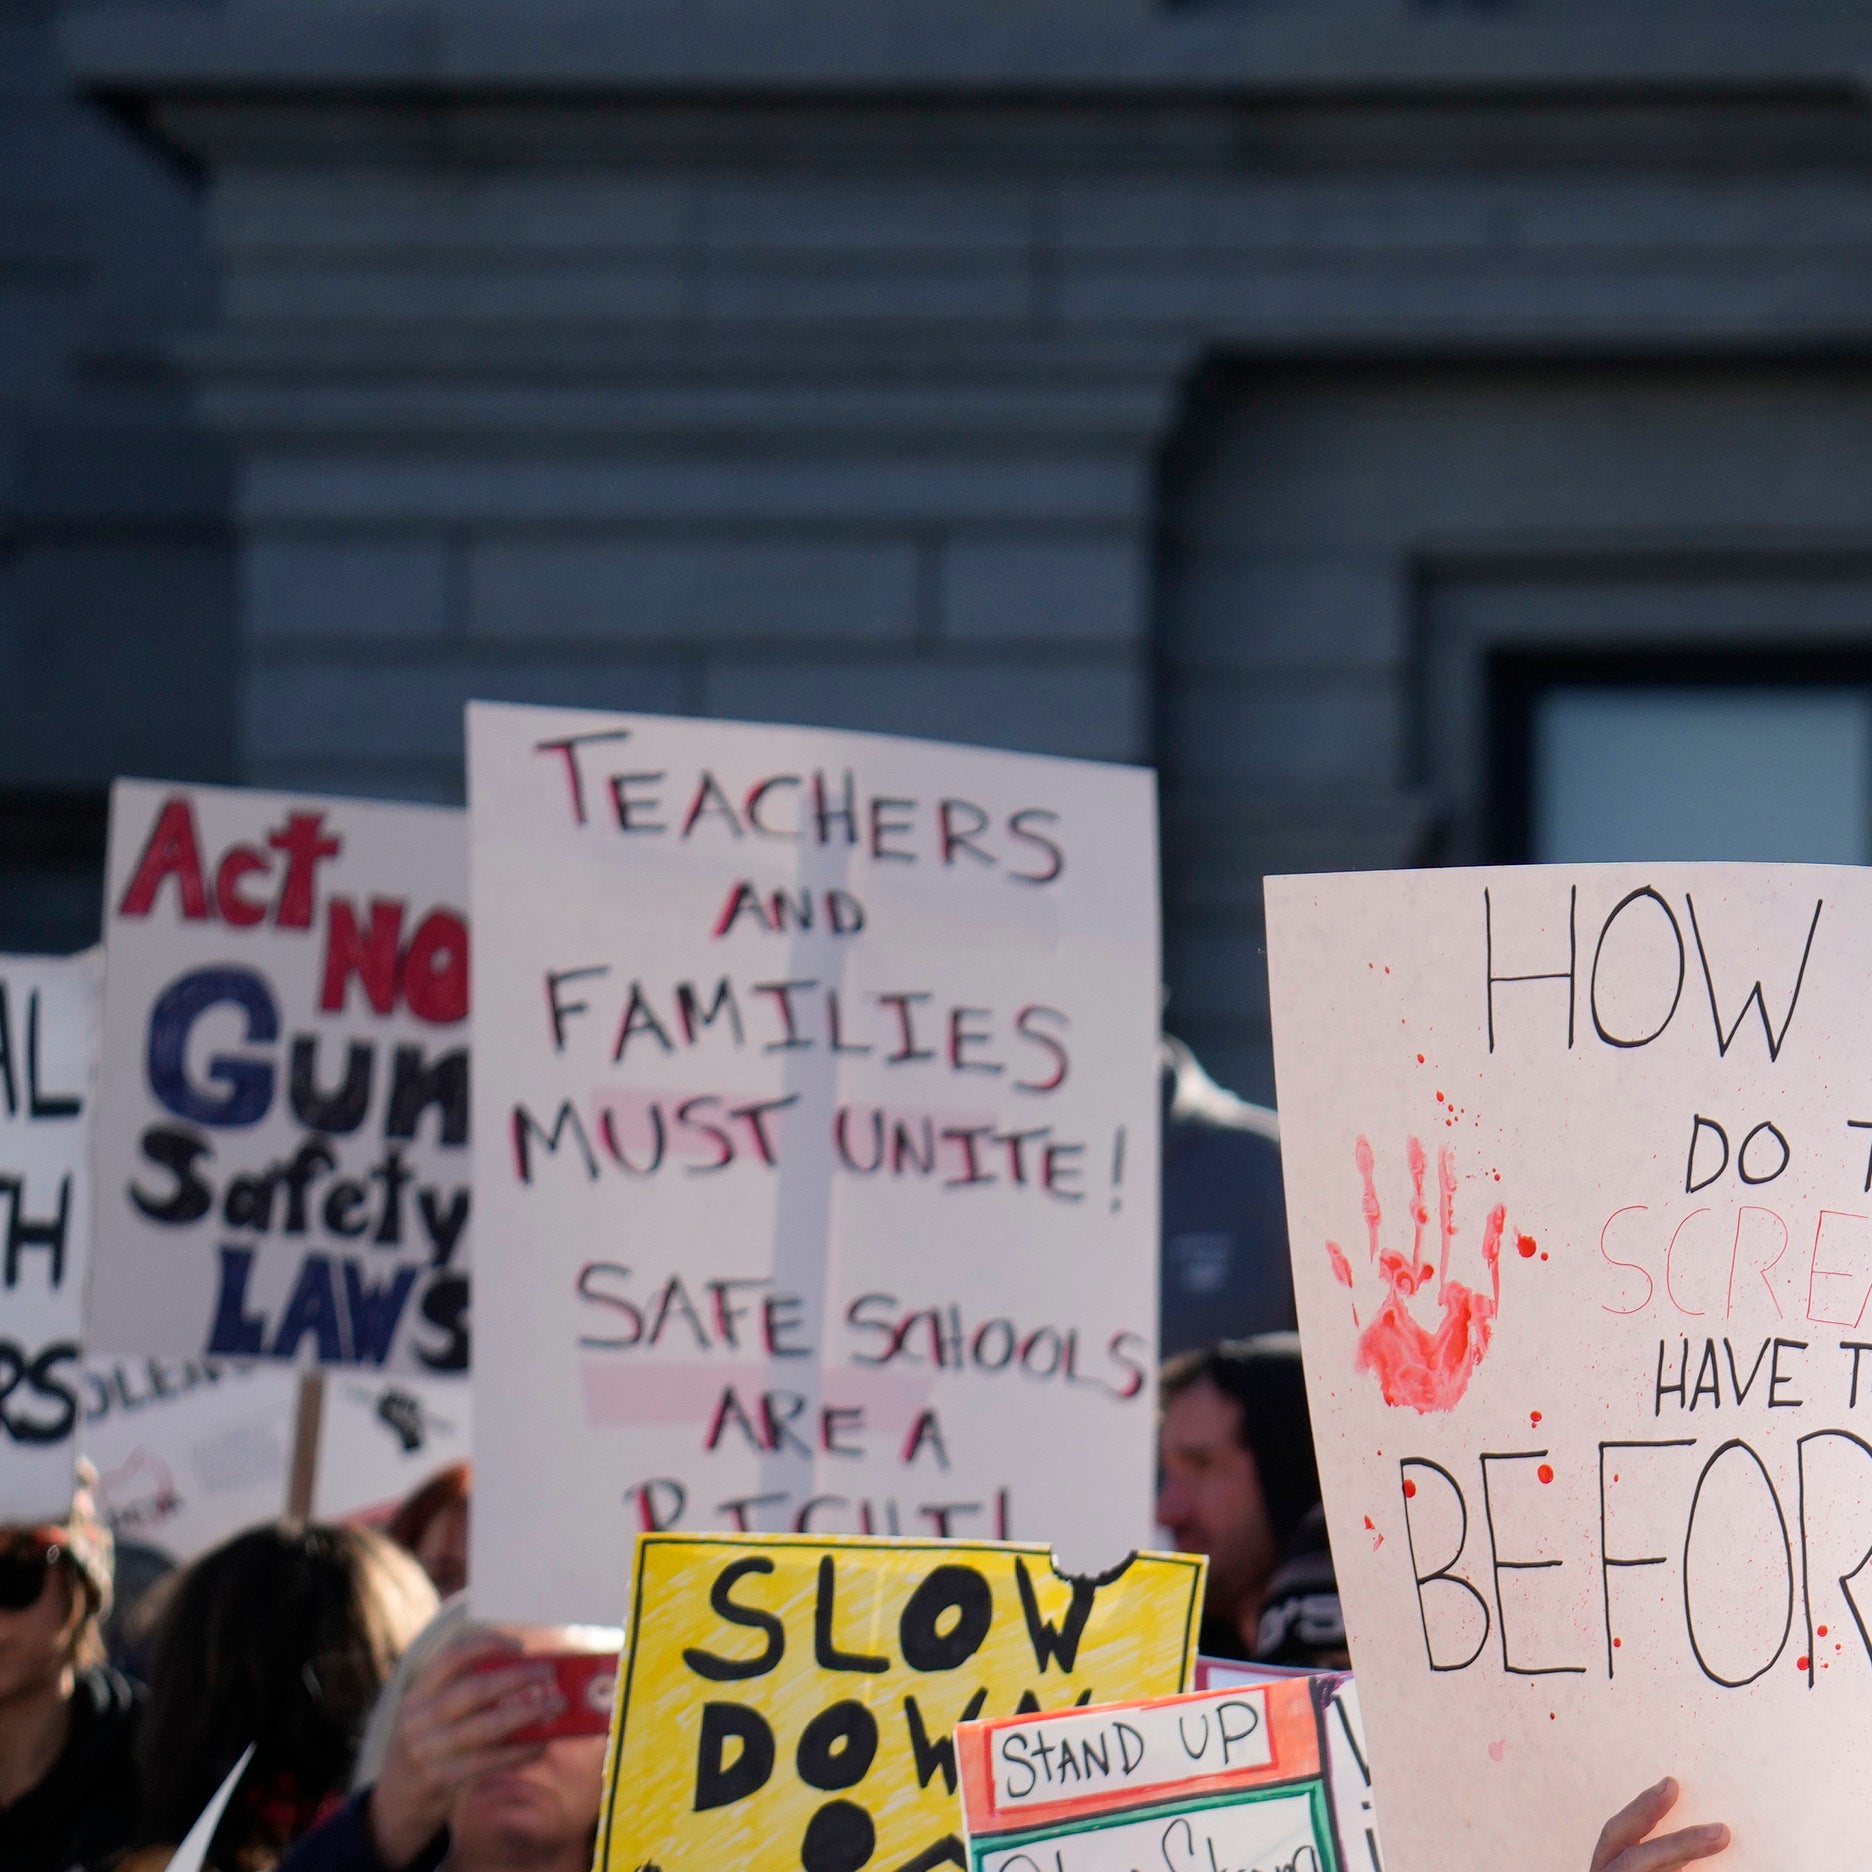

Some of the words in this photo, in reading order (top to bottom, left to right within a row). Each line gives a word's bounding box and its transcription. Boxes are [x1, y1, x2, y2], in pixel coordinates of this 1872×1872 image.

[535, 730, 1063, 885] TEACHERS
[317, 892, 469, 1024] NO
[712, 880, 868, 941] AND
[1483, 885, 1822, 1064] HOW
[544, 966, 1075, 1093] FAMILIES
[129, 1121, 469, 1265] Safety
[511, 1094, 801, 1186] MUST
[833, 1108, 1129, 1215] UNITE!
[1684, 1114, 1791, 1194] DO
[206, 1245, 469, 1377] LAWS
[576, 1262, 813, 1358] SAFE
[844, 1292, 1148, 1400] SCHOOLS
[703, 1389, 868, 1458] ARE
[901, 1406, 950, 1469] A
[1656, 1339, 1808, 1417] HAVE
[683, 1553, 1100, 1683] SLOW
[1178, 1700, 1259, 1766] UP
